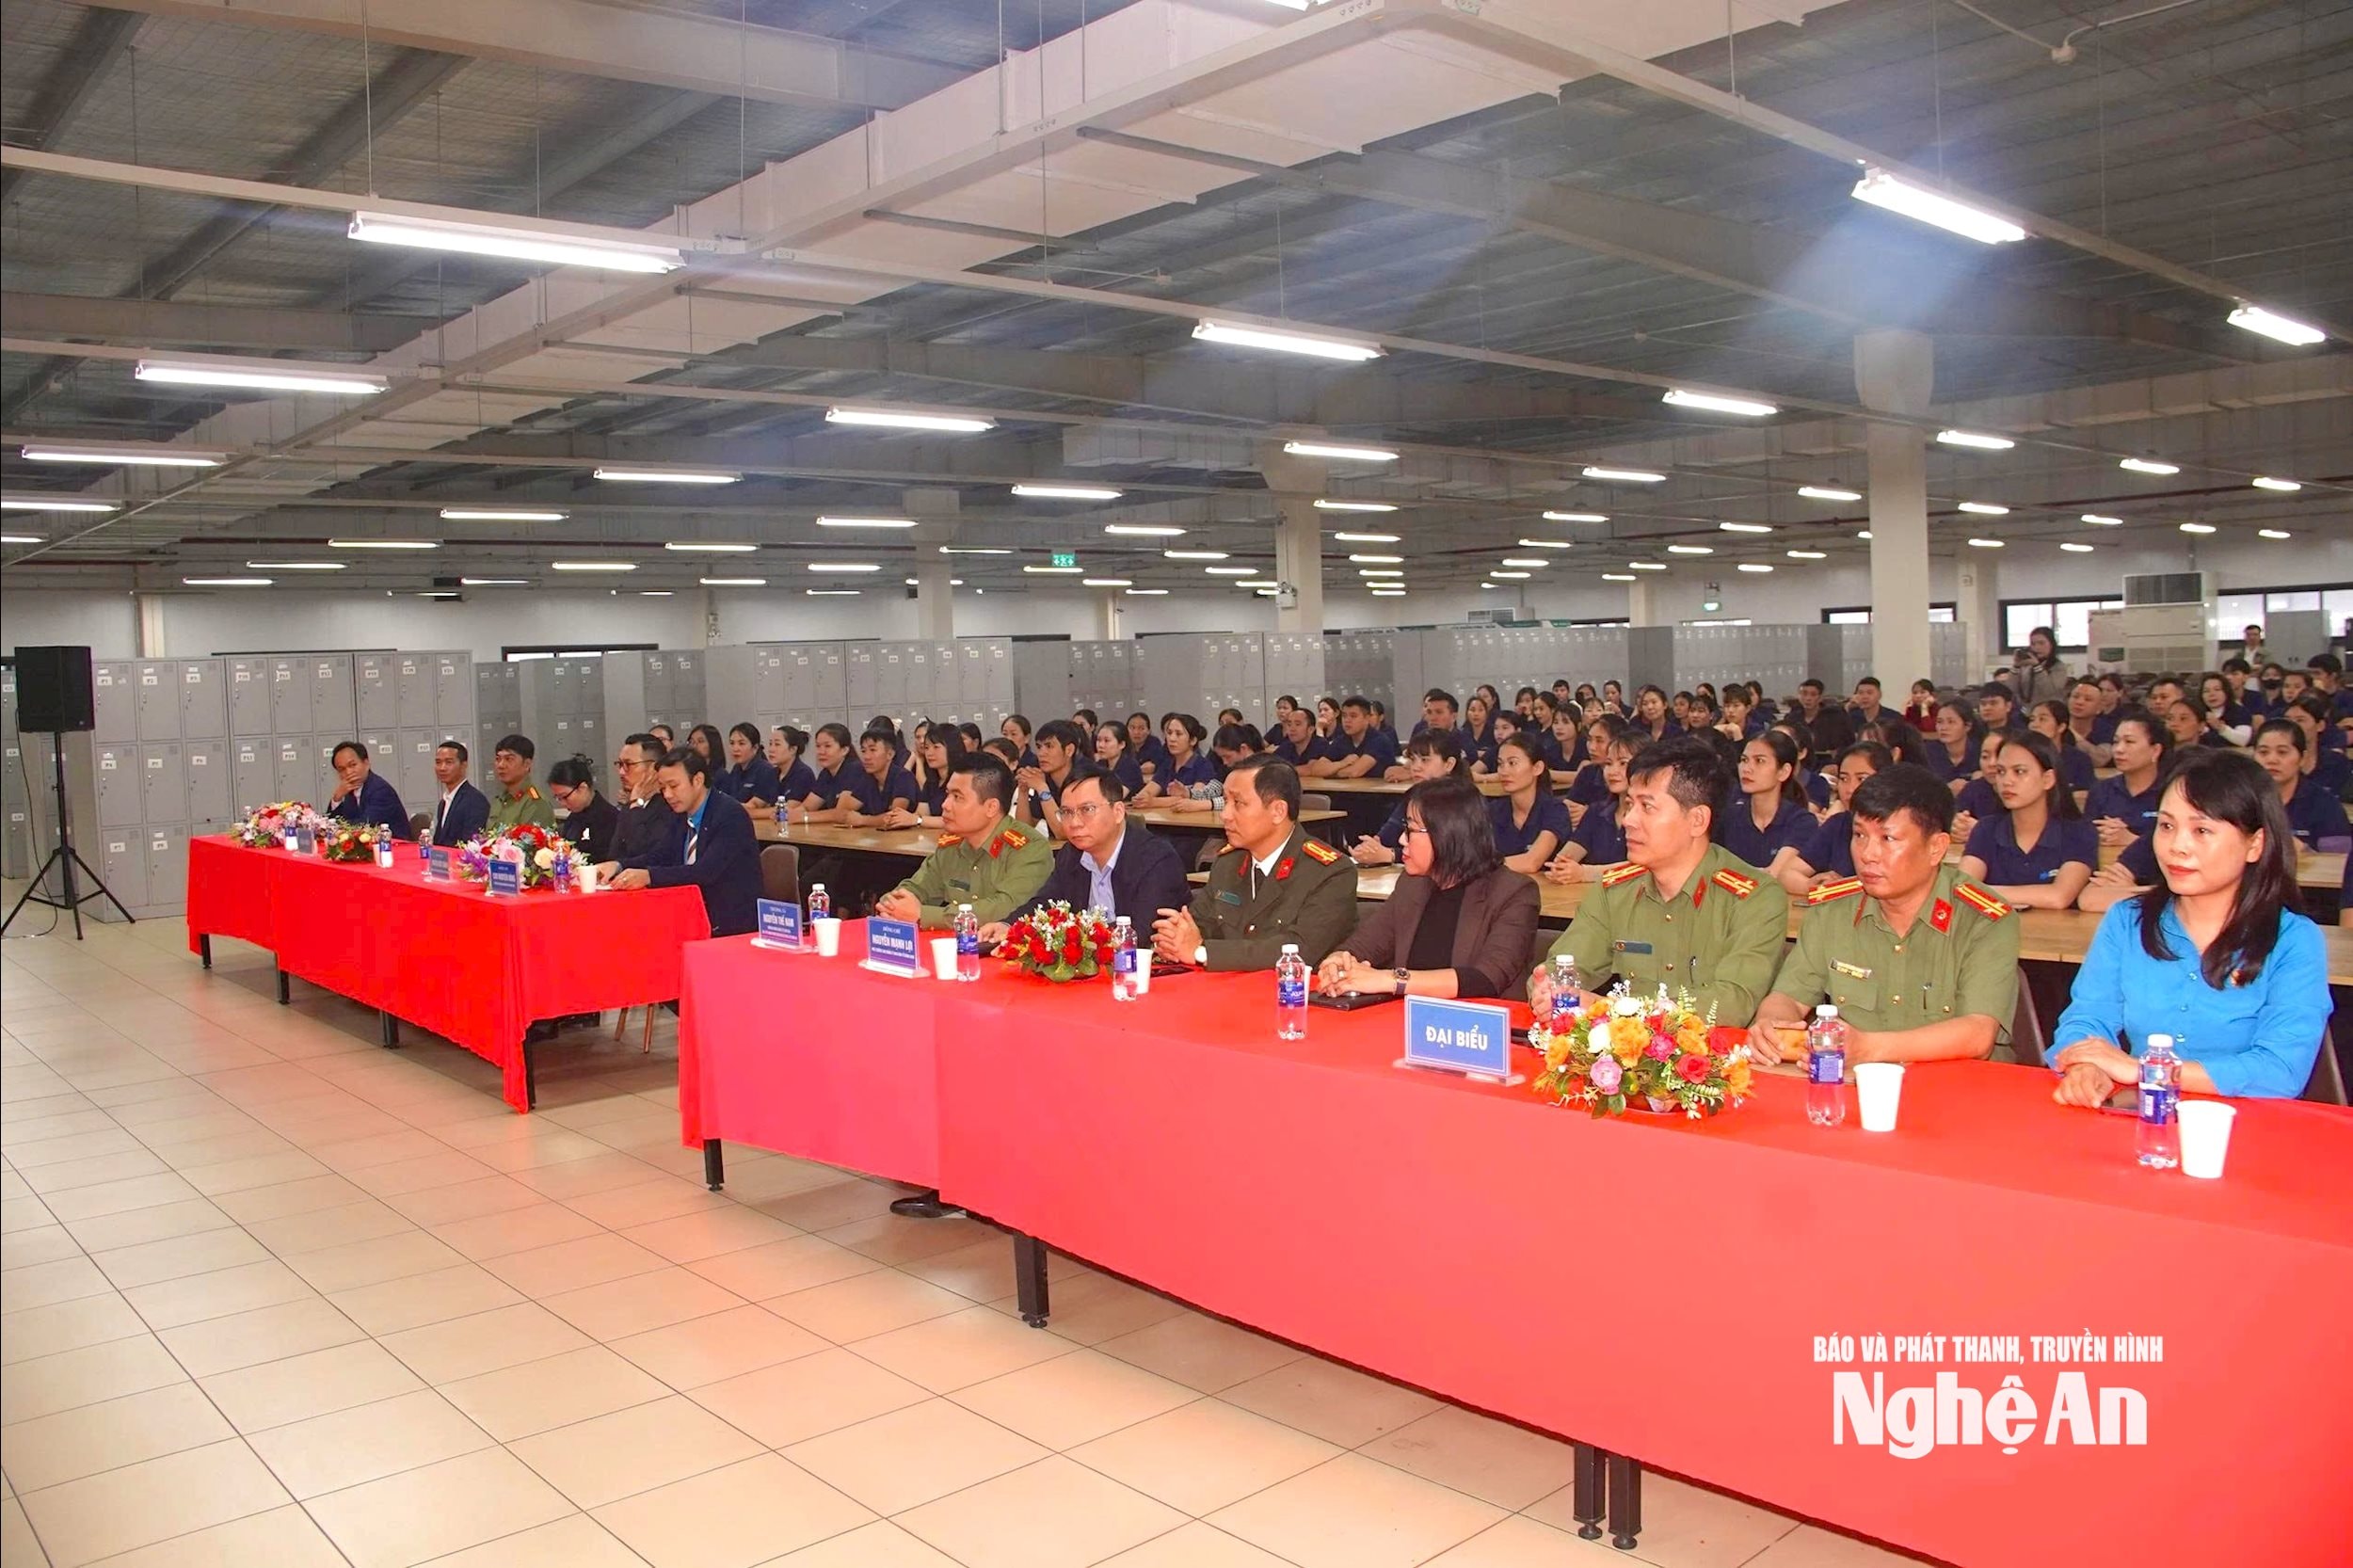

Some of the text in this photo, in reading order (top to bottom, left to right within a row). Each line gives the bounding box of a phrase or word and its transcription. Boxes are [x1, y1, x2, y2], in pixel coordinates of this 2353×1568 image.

[872, 932, 890, 947] NGUYỄN
[890, 936, 904, 951] MẠNH
[905, 939, 914, 953] LỢI
[1425, 1024, 1488, 1051] ĐẠI BIỂU
